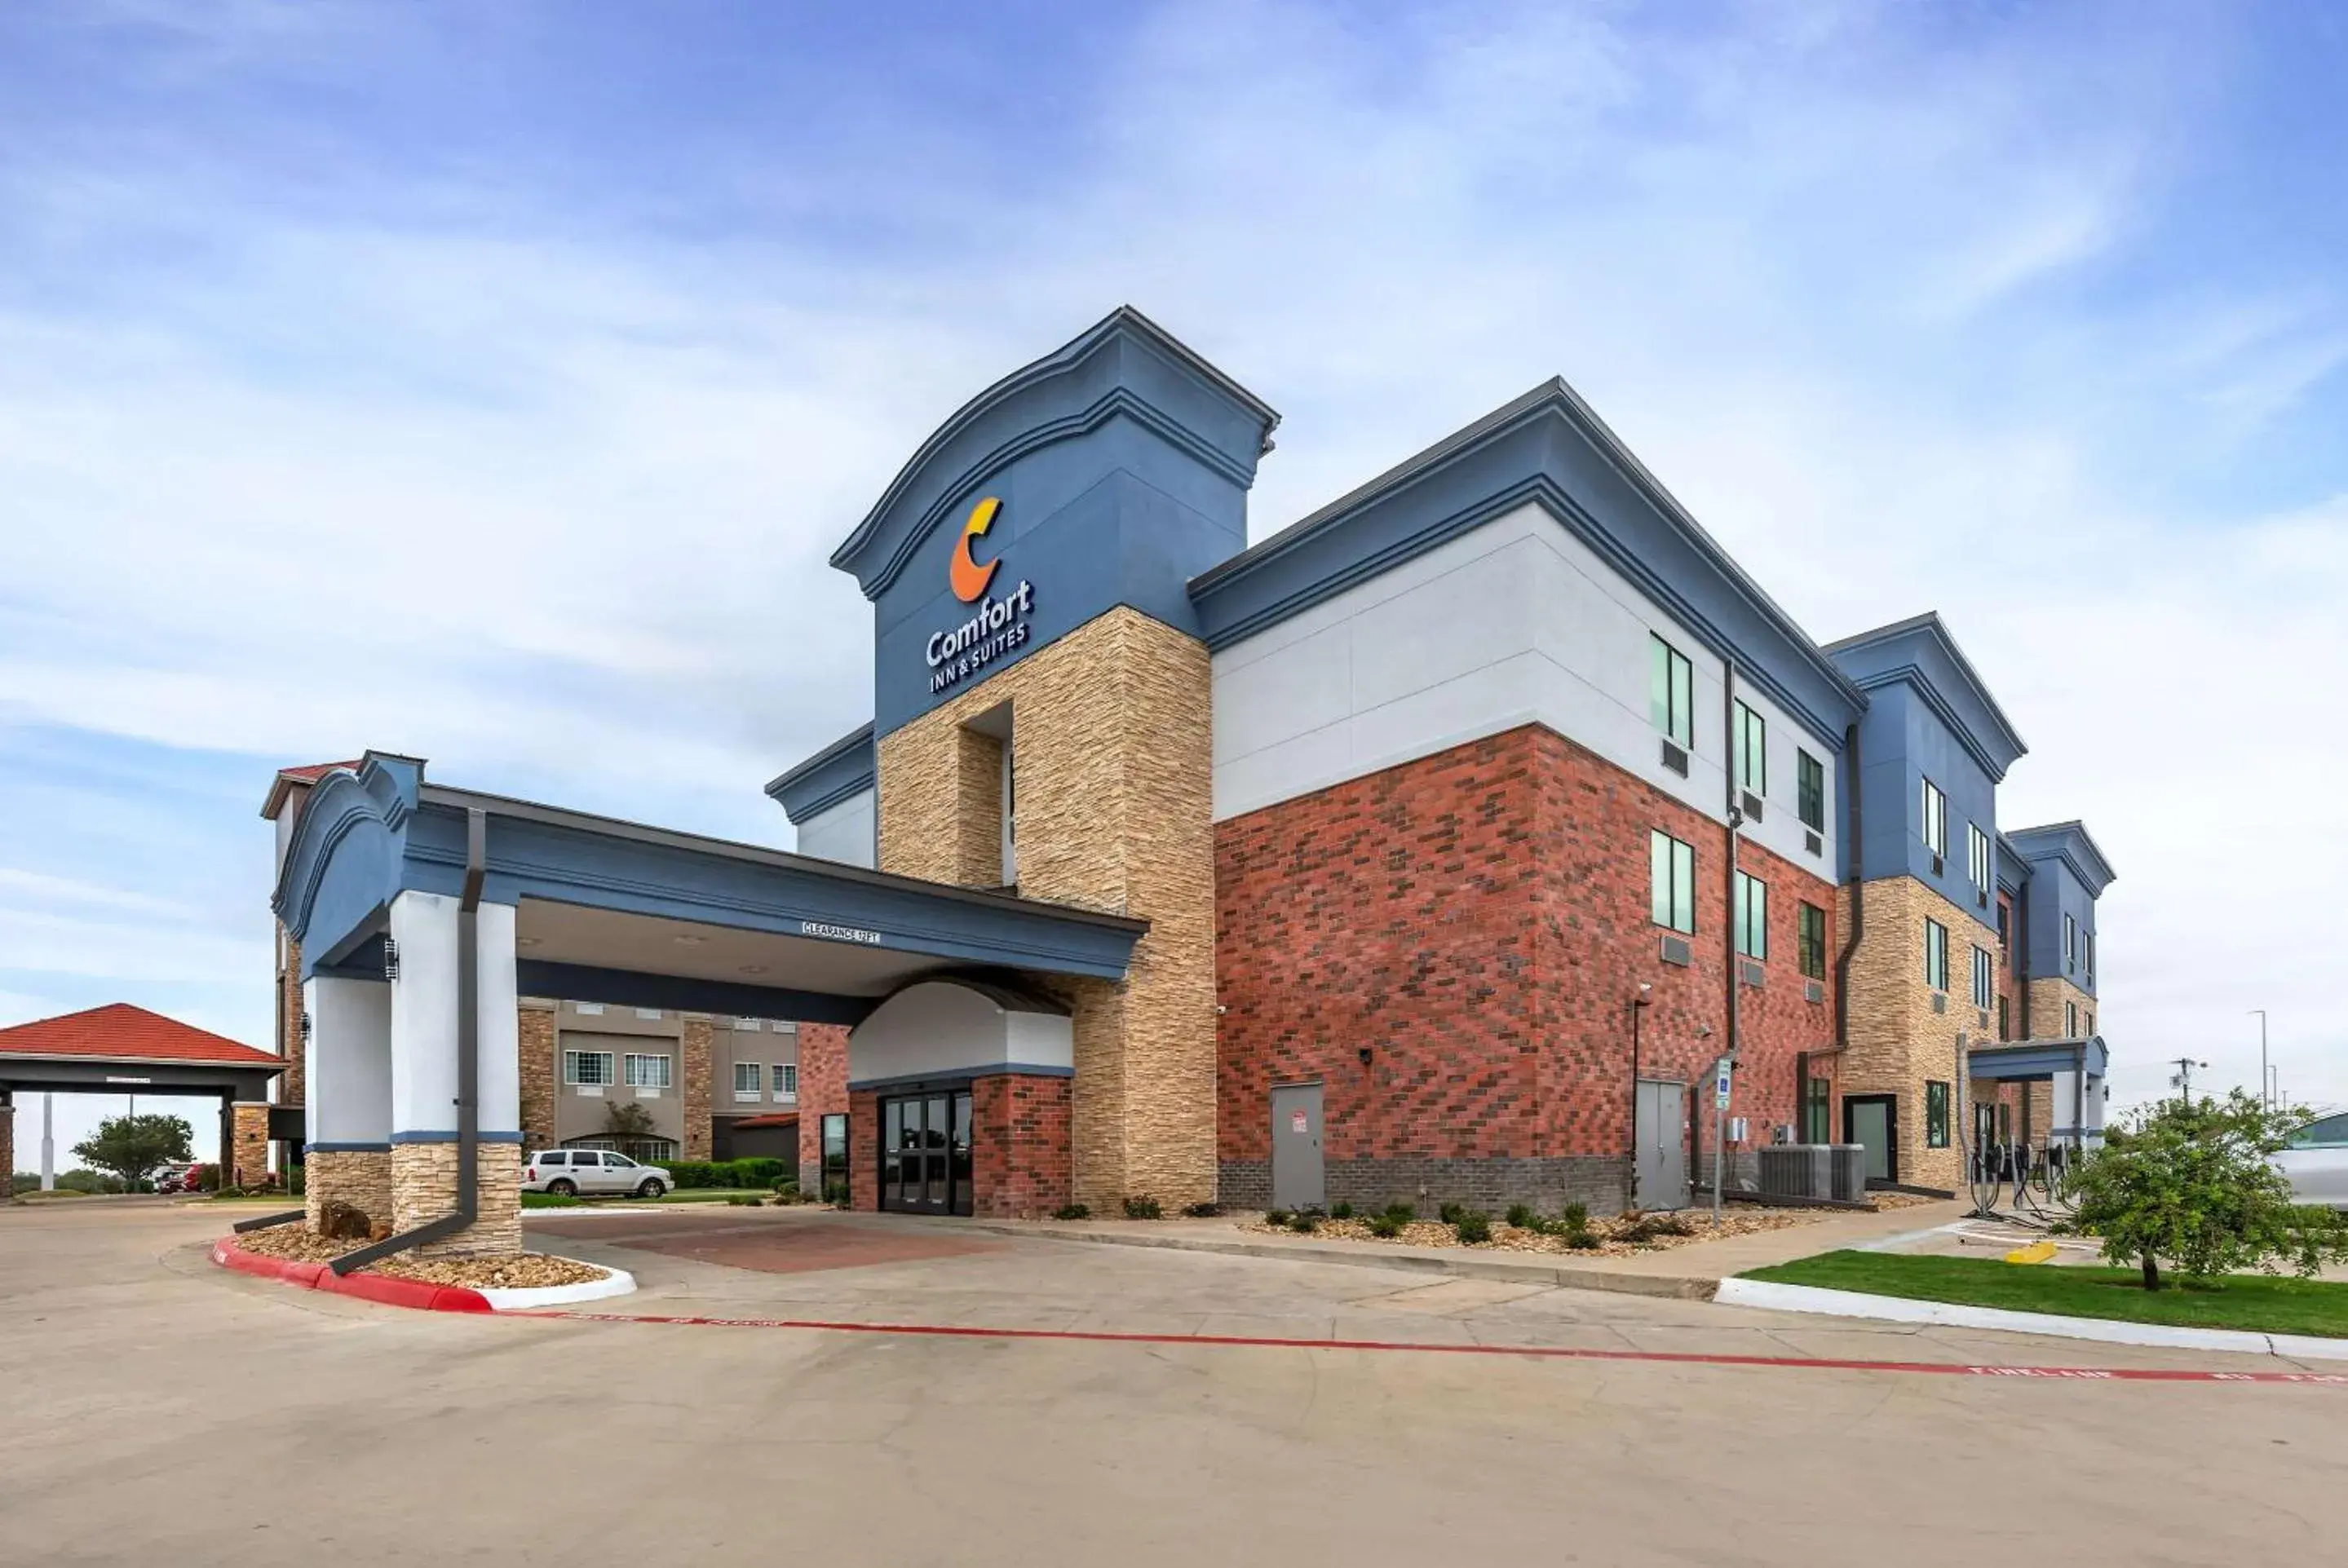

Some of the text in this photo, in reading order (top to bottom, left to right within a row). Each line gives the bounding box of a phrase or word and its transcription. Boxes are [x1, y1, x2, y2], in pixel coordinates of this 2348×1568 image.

[926, 580, 1030, 667] Comfort
[931, 623, 1025, 693] INN & SUITES
[804, 922, 856, 939] CLEARANCE
